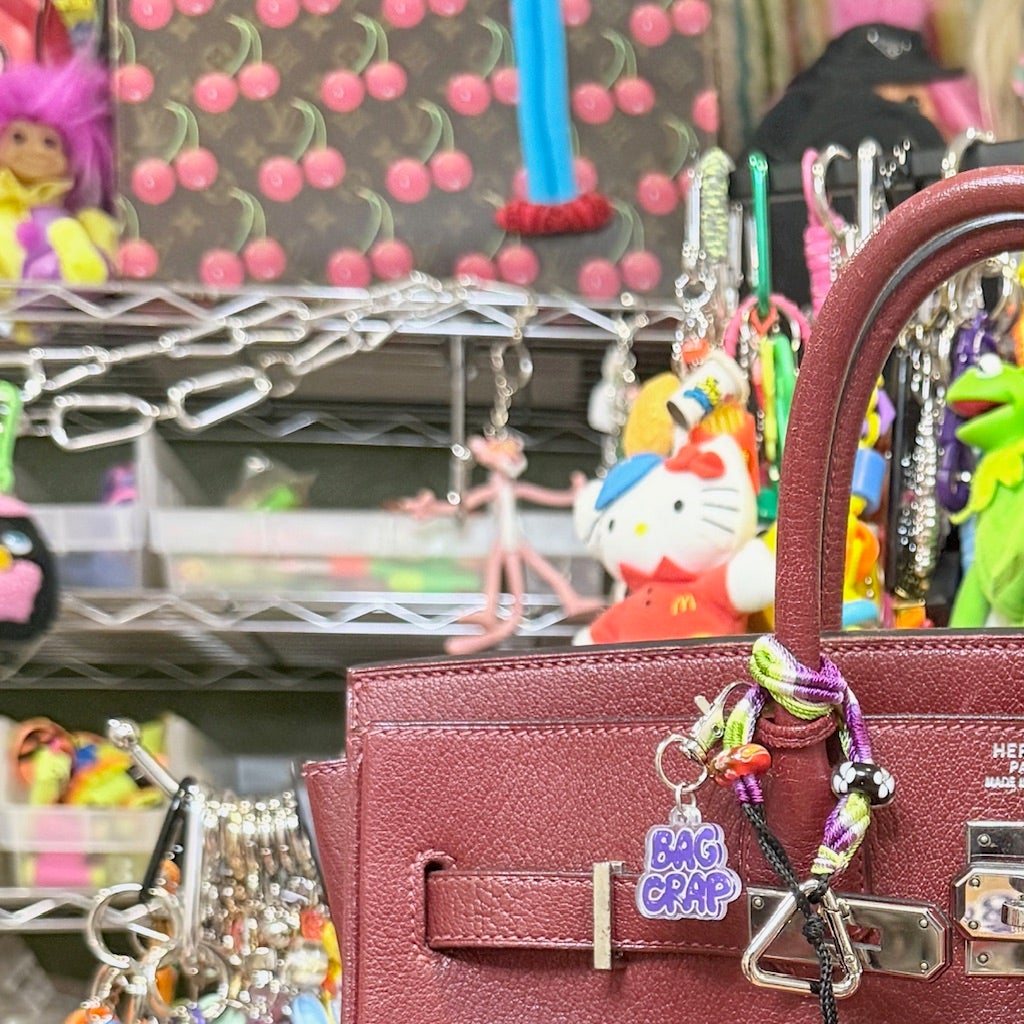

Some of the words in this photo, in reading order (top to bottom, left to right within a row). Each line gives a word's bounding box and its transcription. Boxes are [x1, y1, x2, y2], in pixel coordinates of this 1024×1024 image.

[985, 776, 1016, 788] MADE
[650, 827, 720, 871] BAG
[641, 871, 734, 914] CRAP
